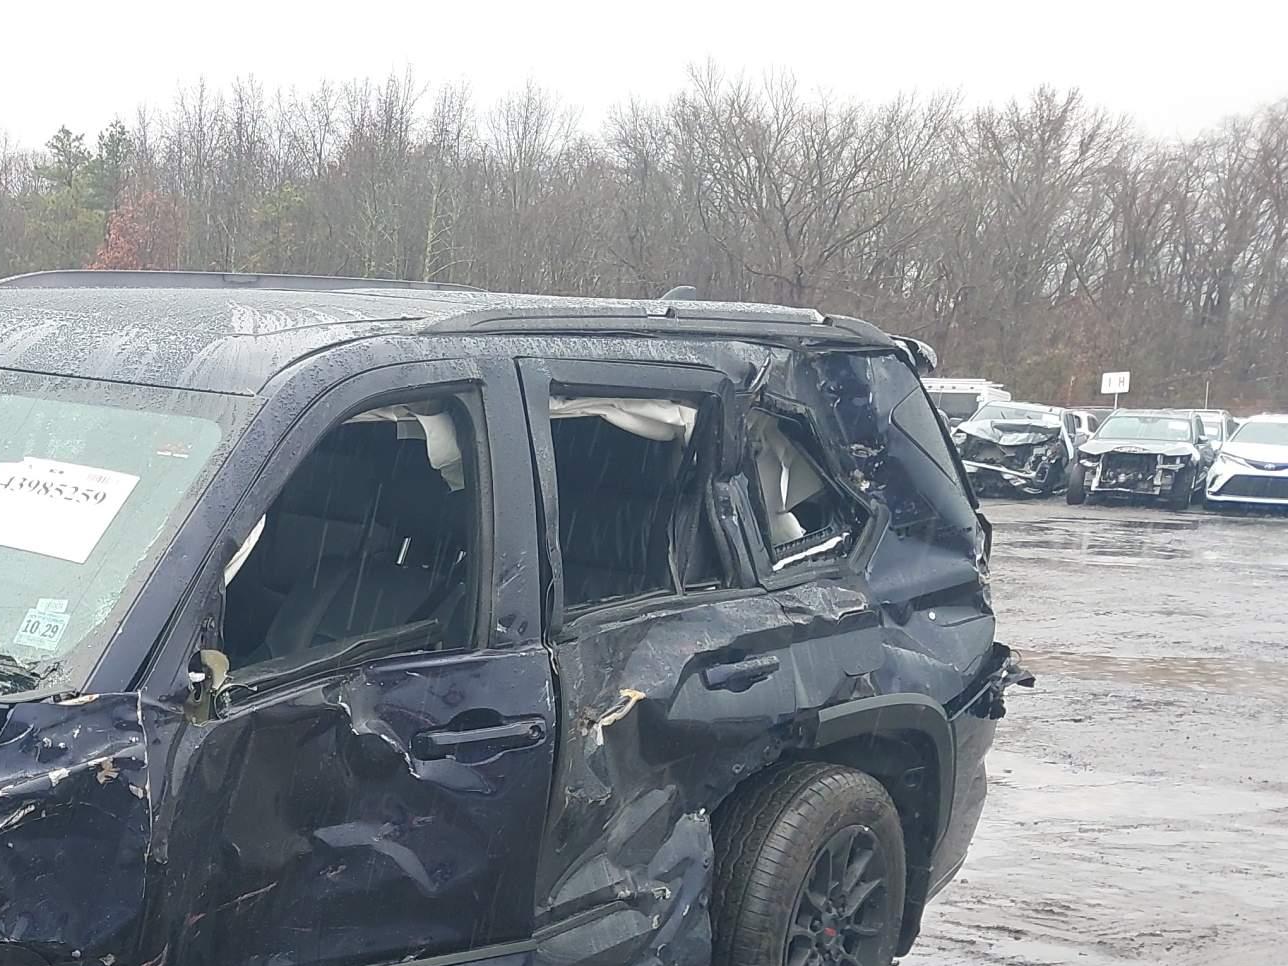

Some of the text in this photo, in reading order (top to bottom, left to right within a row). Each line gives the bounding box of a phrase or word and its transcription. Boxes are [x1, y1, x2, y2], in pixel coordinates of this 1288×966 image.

[0, 475, 107, 505] 43985259
[22, 619, 59, 639] 10 29
